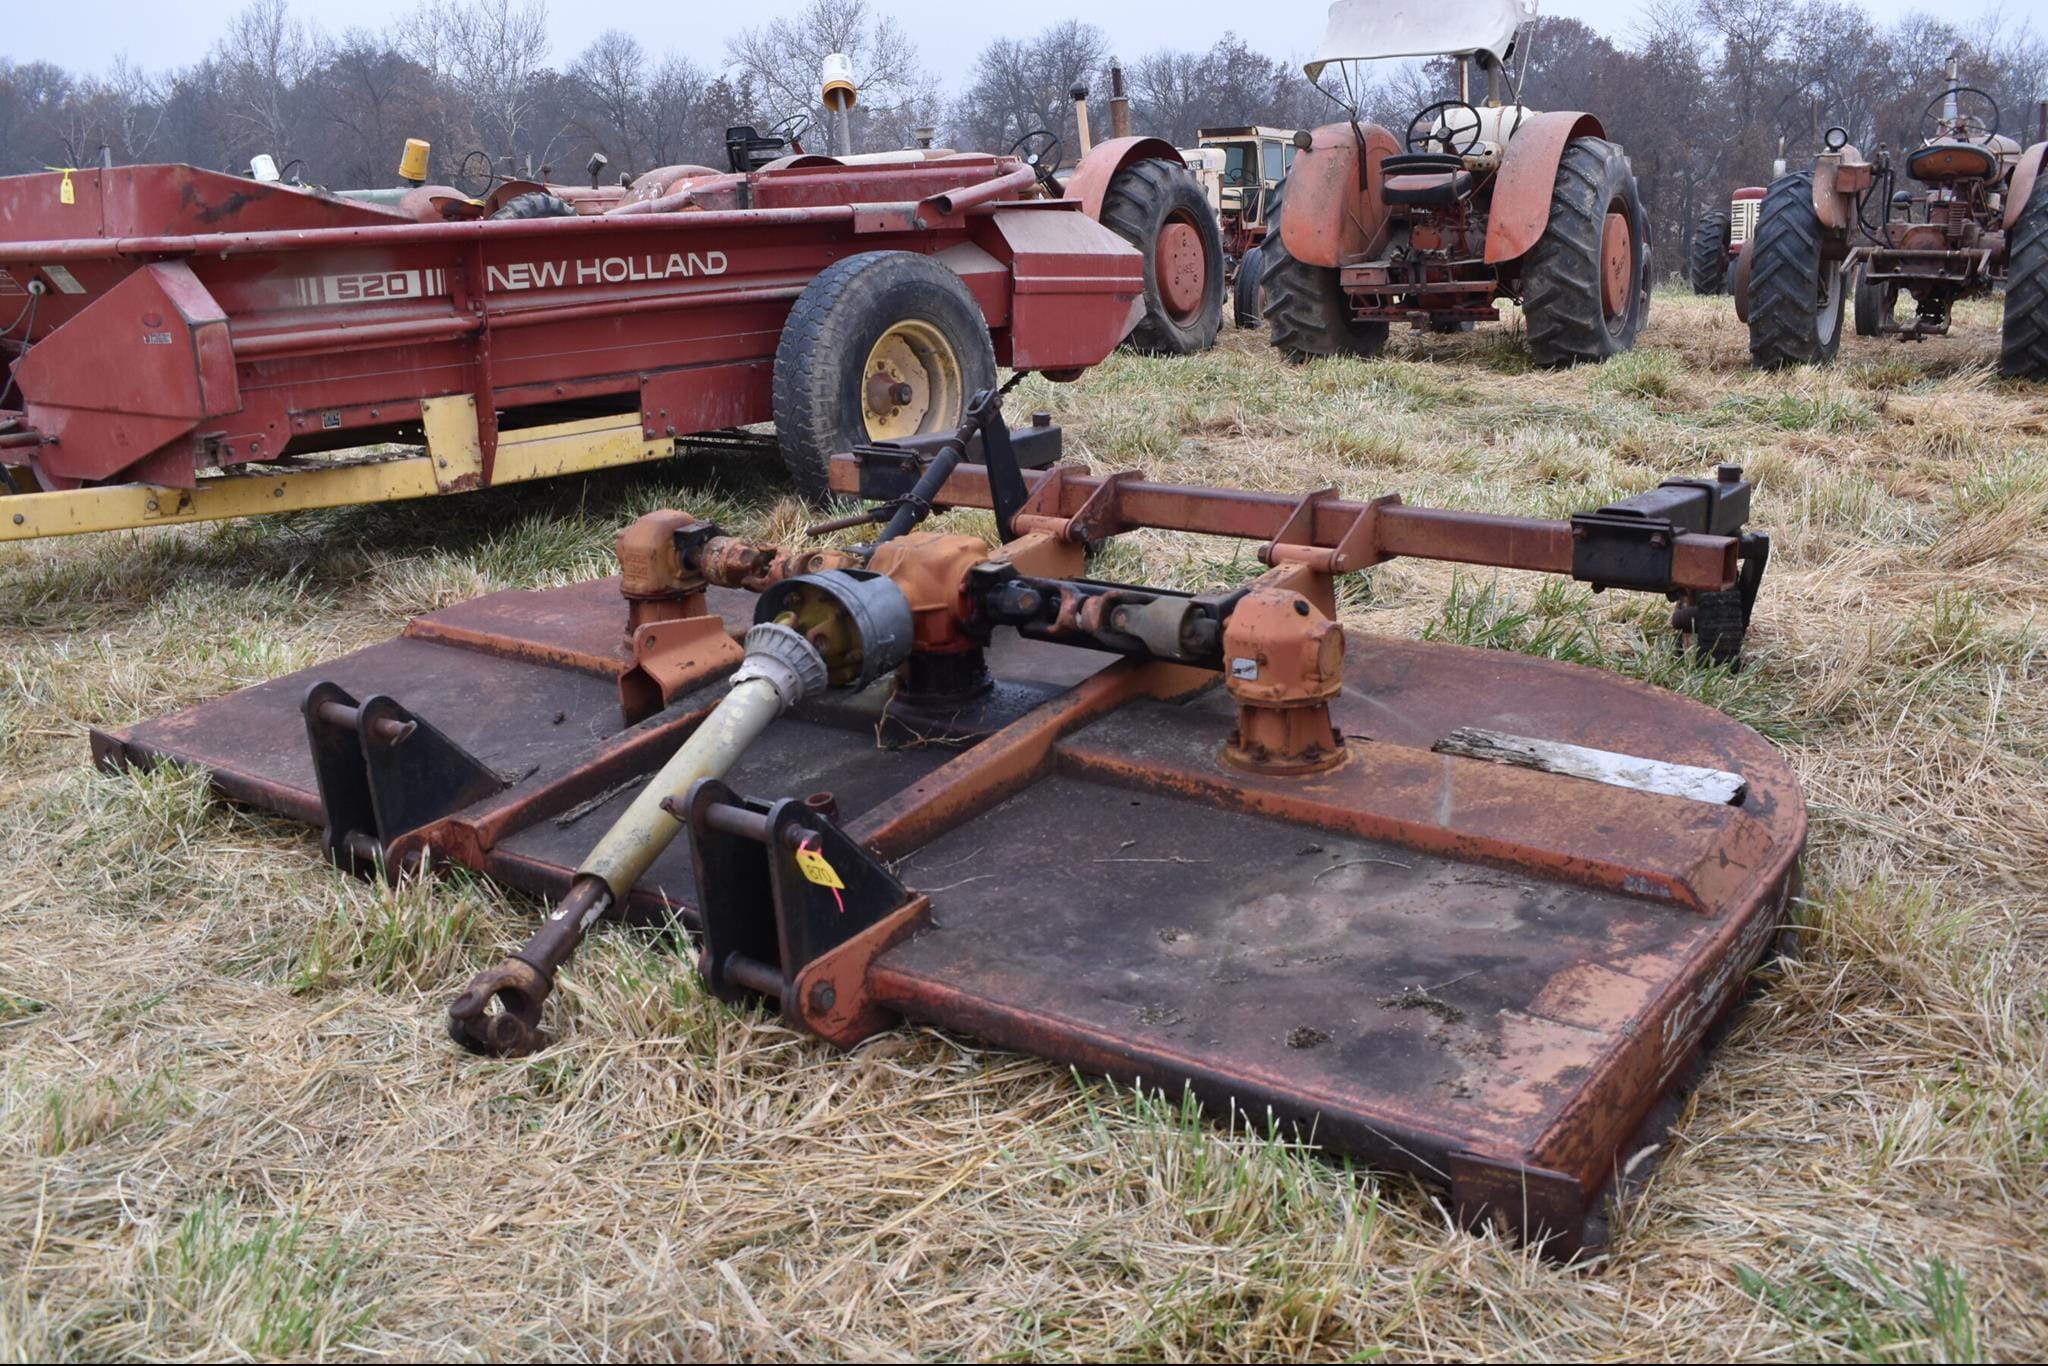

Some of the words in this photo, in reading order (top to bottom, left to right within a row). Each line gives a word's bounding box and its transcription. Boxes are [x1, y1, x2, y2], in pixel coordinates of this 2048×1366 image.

[337, 273, 409, 299] 520
[487, 260, 568, 292] NEW
[576, 251, 728, 285] HOLLAND
